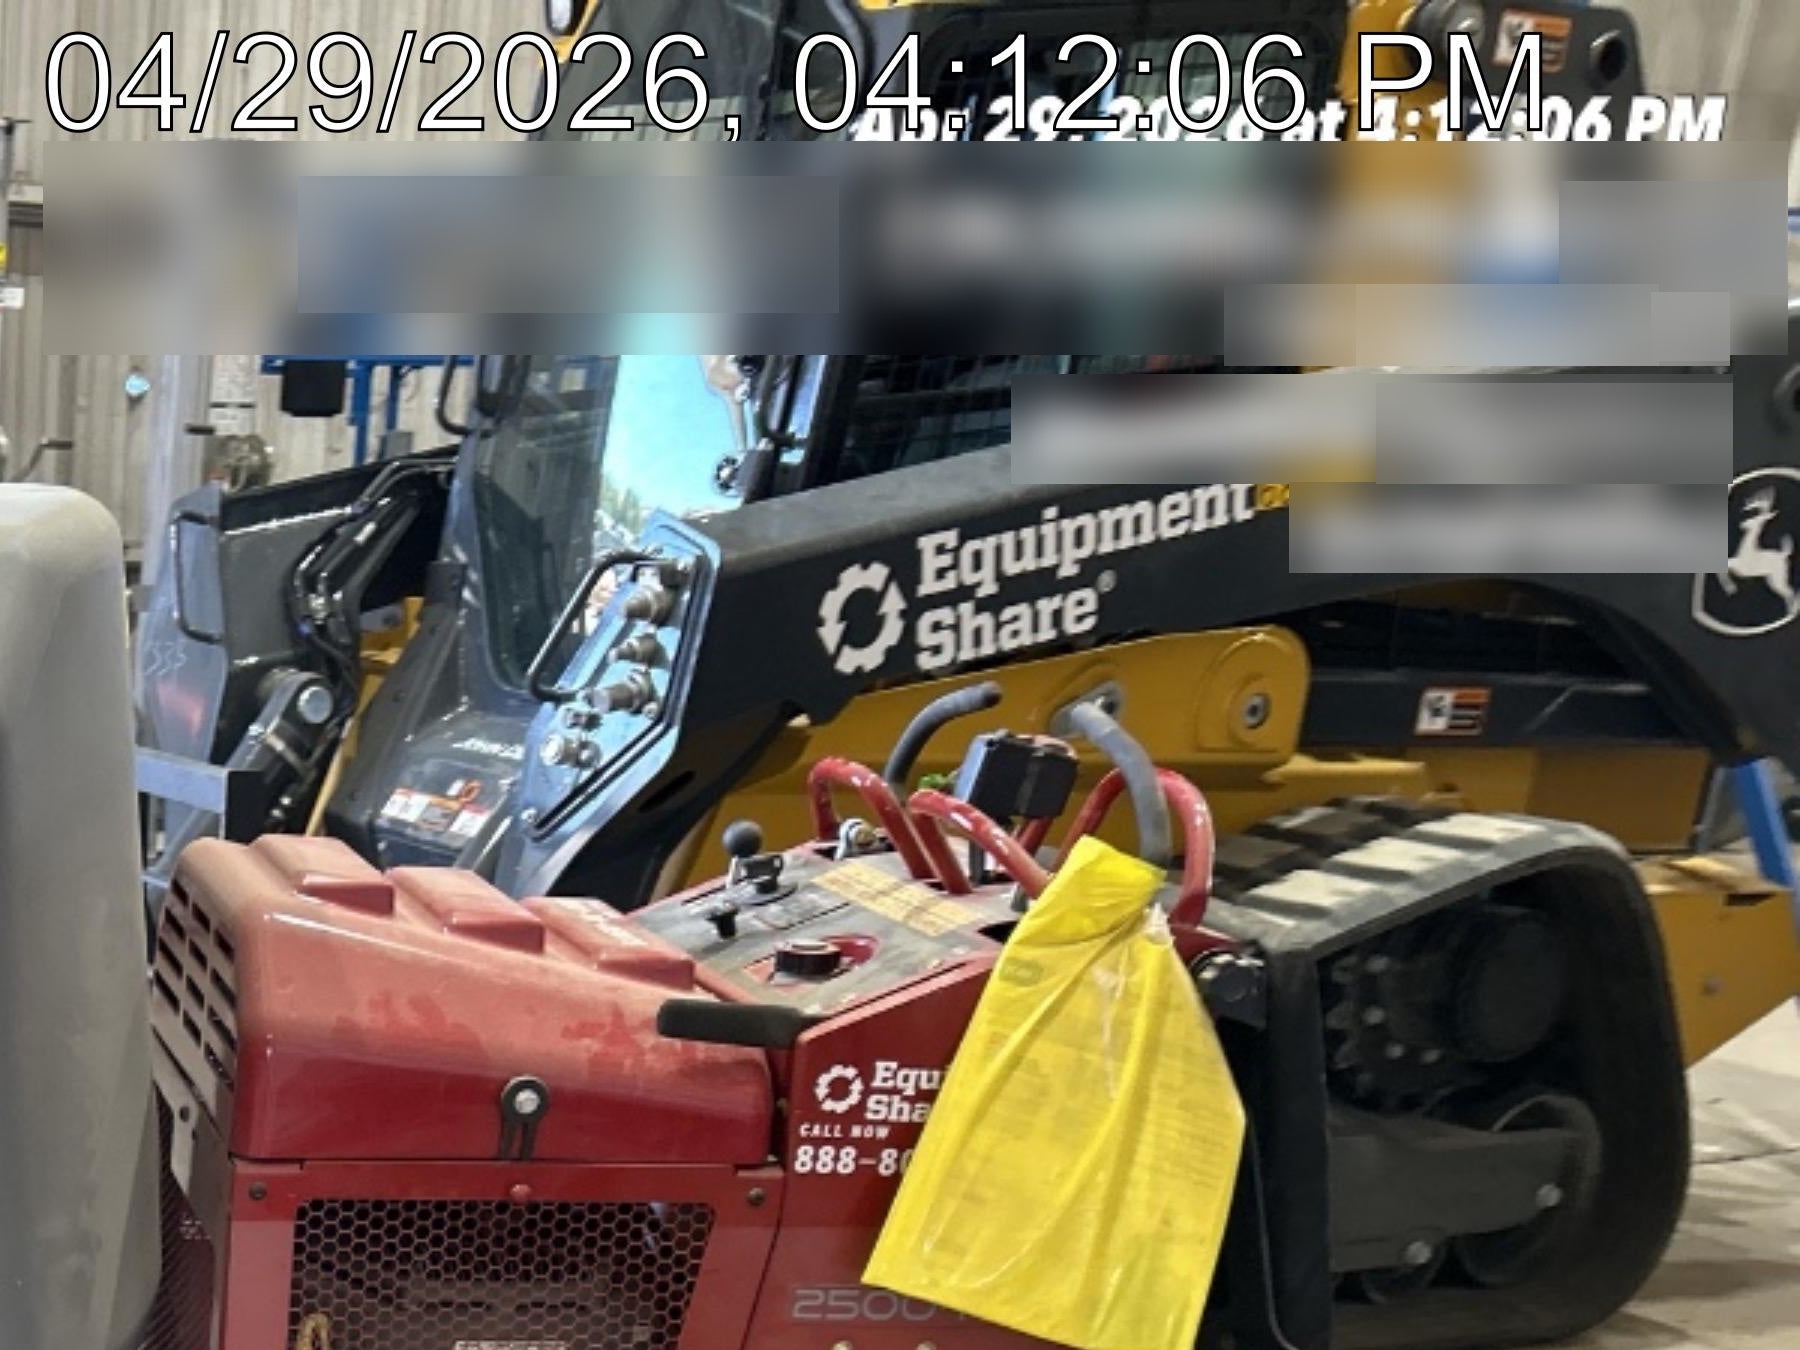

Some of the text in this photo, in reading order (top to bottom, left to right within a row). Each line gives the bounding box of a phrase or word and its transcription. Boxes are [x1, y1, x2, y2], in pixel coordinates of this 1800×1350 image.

[916, 484, 1255, 598] Equipment
[870, 1060, 948, 1096] Equ
[799, 1122, 890, 1139] CALL NOW
